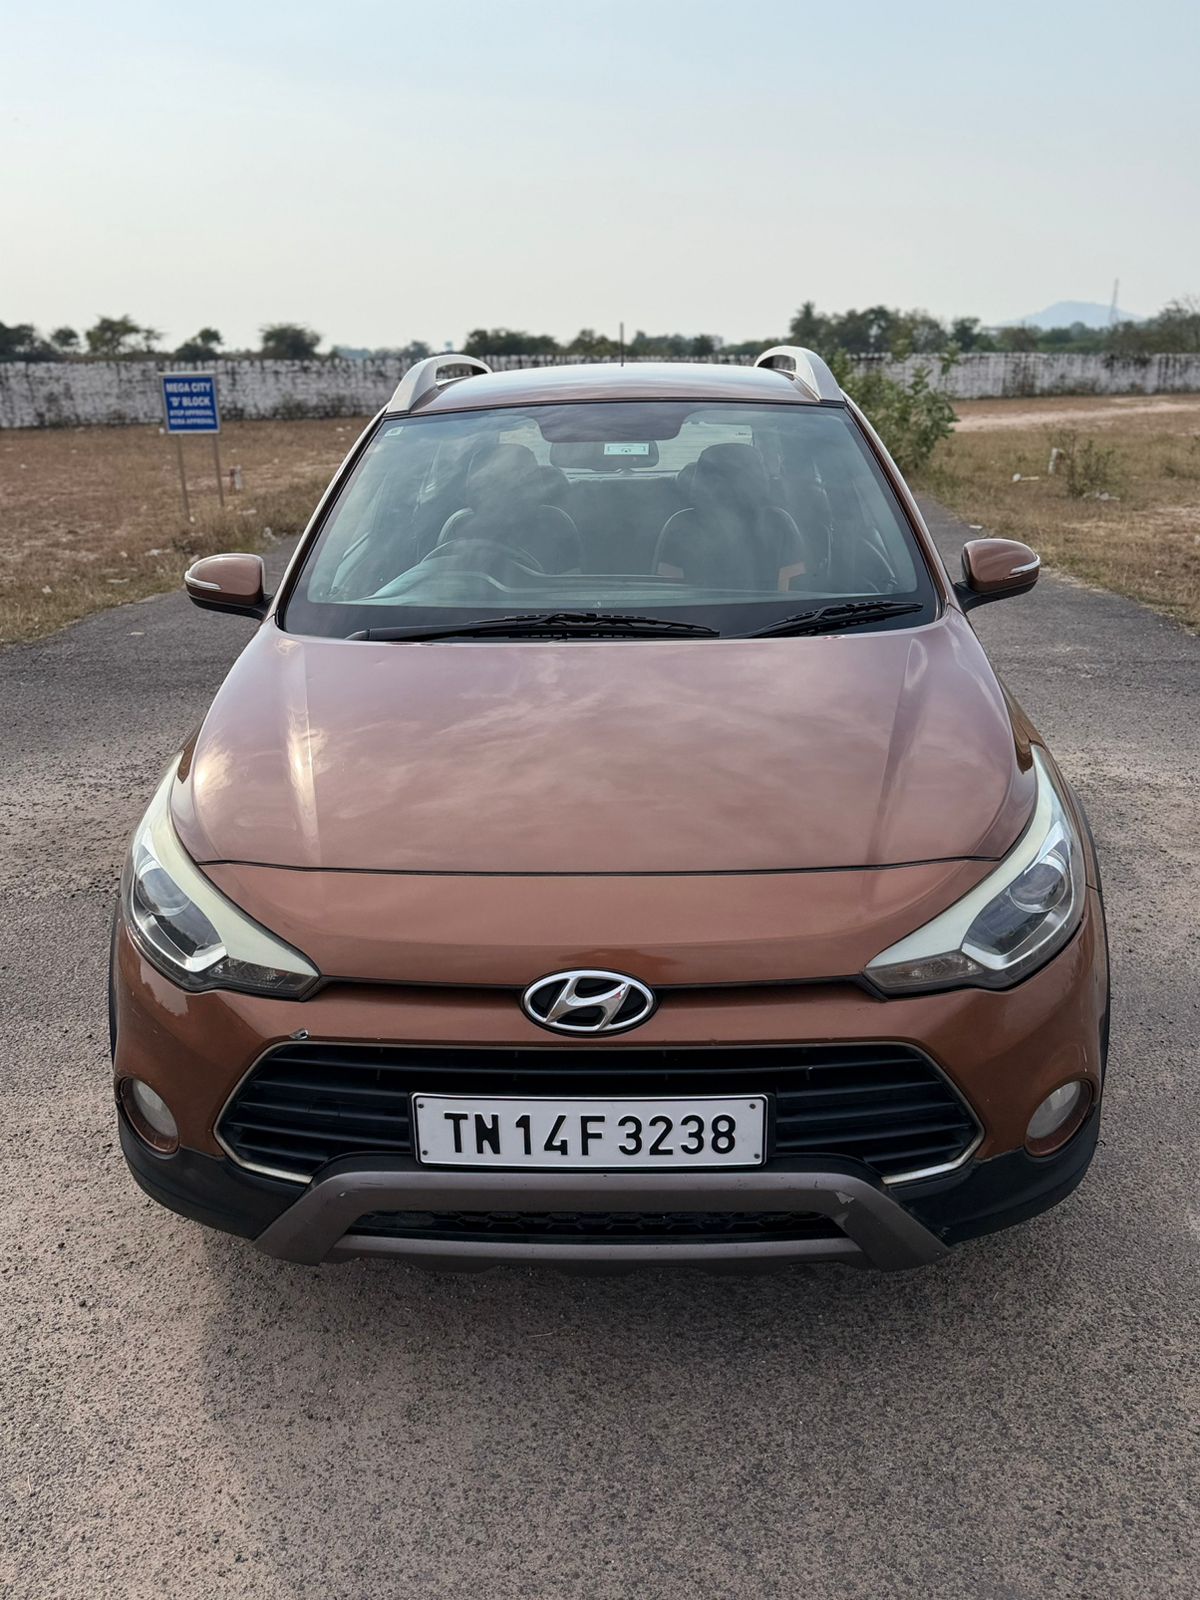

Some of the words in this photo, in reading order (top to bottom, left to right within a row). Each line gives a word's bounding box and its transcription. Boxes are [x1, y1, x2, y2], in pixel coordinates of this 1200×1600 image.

[166, 382, 190, 393] MEGA
[191, 382, 211, 393] CITY
[182, 396, 211, 407] BLOCK
